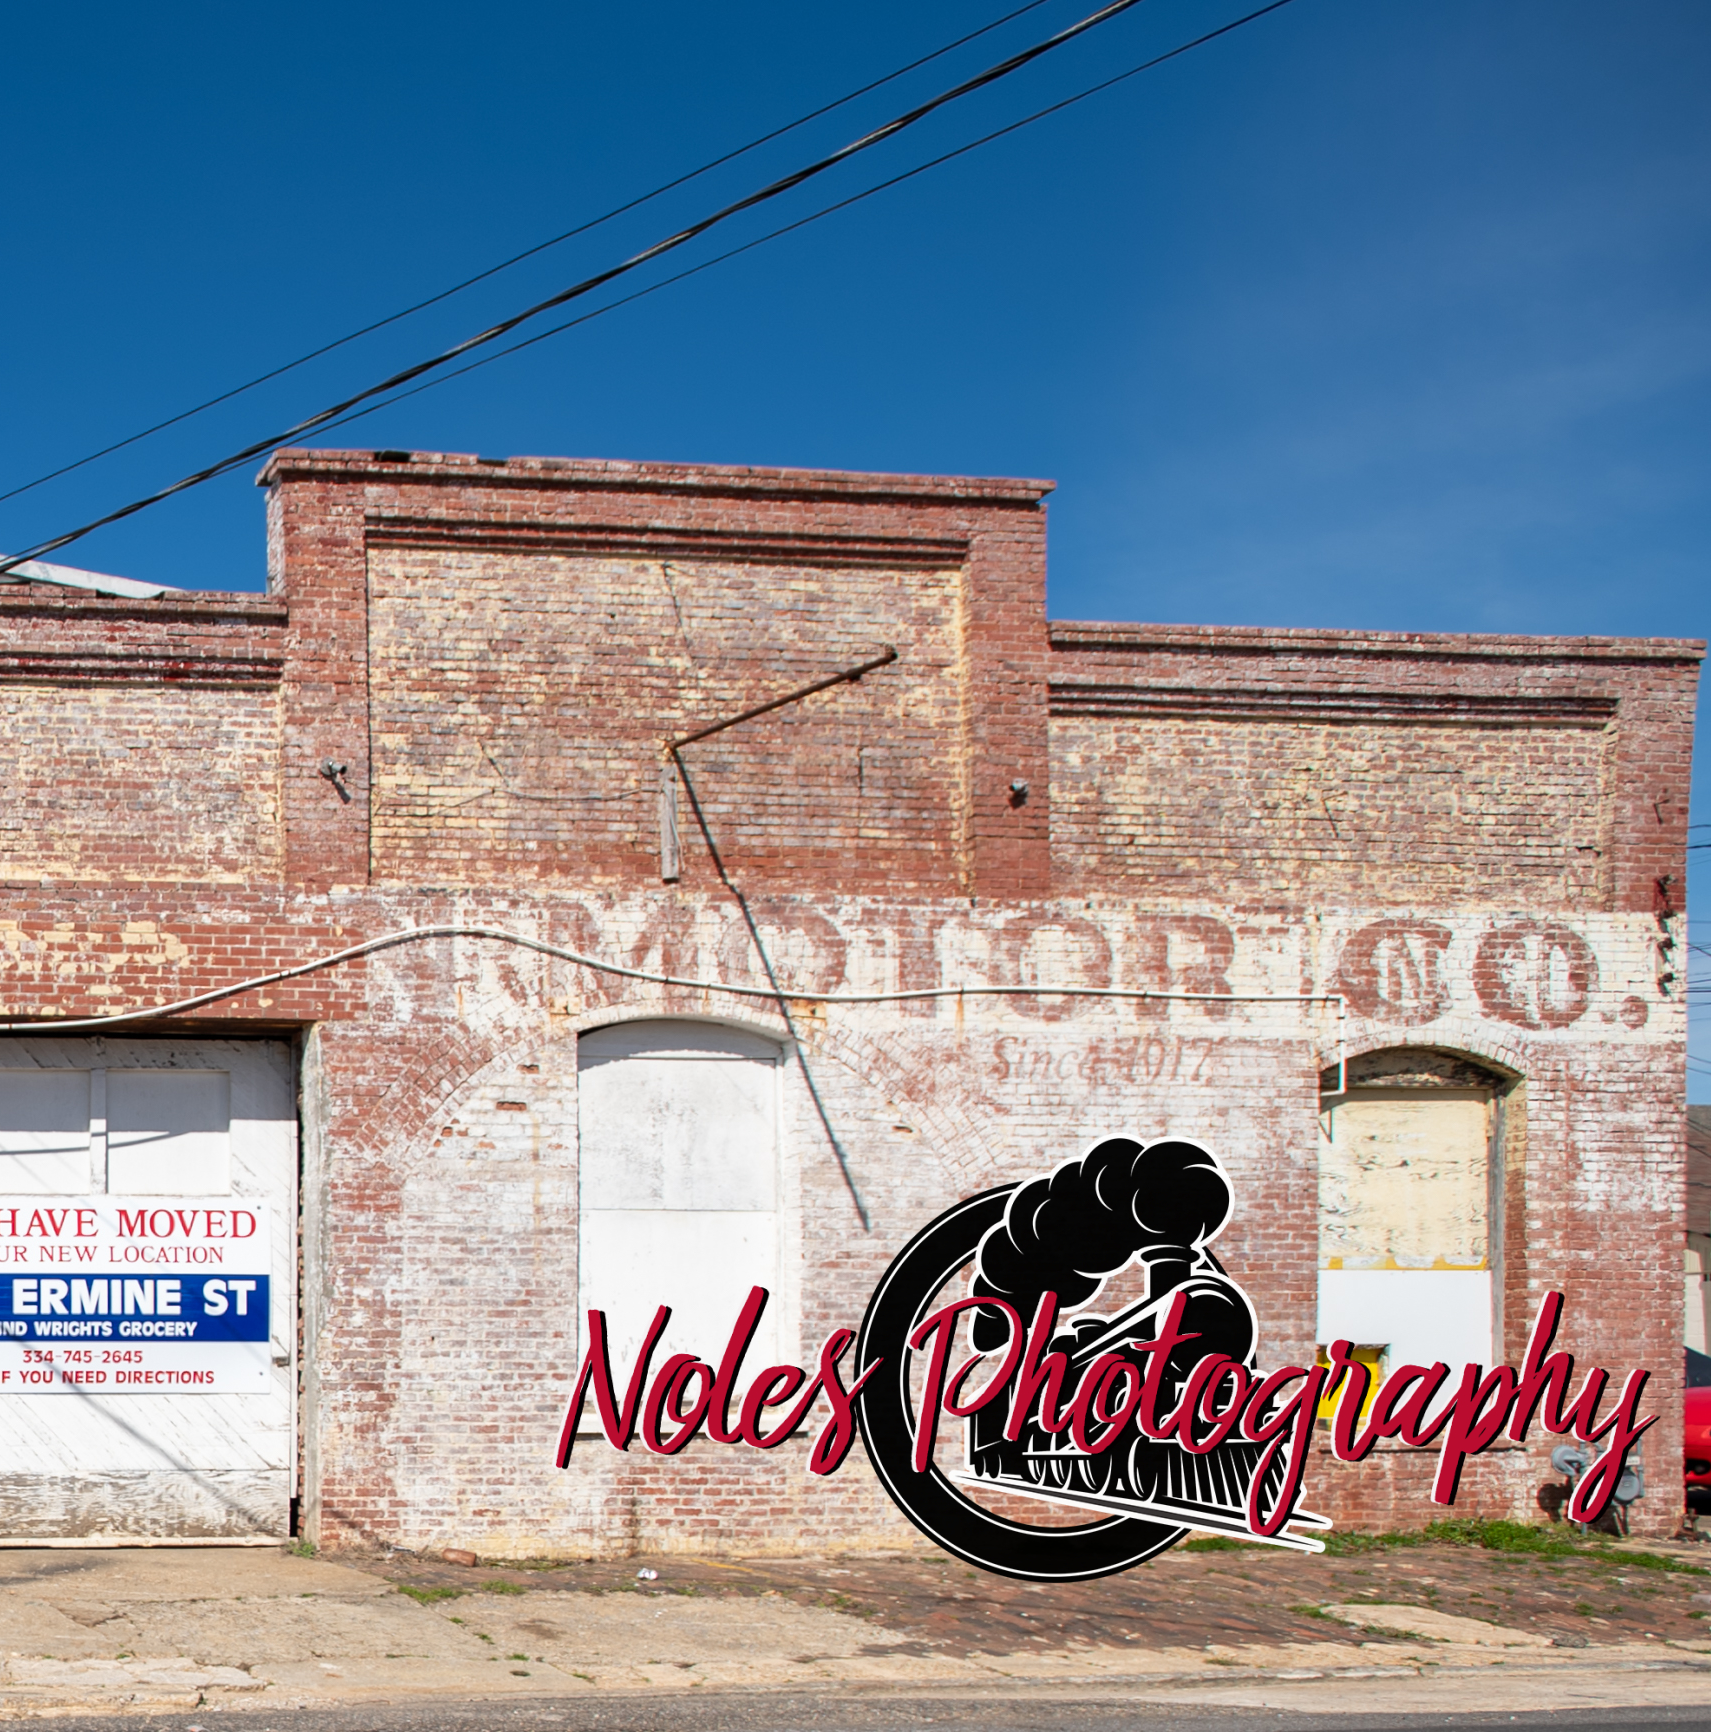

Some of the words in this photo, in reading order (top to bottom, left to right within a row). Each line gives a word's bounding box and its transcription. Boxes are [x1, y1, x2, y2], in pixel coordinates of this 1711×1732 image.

[116, 1208, 257, 1239] MOVED
[40, 1245, 97, 1262] NEW
[109, 1246, 223, 1263] LOCATION
[12, 1278, 181, 1315] ERMINE
[203, 1278, 257, 1316] ST
[34, 1321, 113, 1337] WRIGHTS
[119, 1321, 198, 1337] GROCERY
[23, 1349, 143, 1364] 334-745-2645
[19, 1370, 54, 1385] YOU
[61, 1370, 108, 1384] NEED
[115, 1370, 214, 1385] DIRECTIONS
